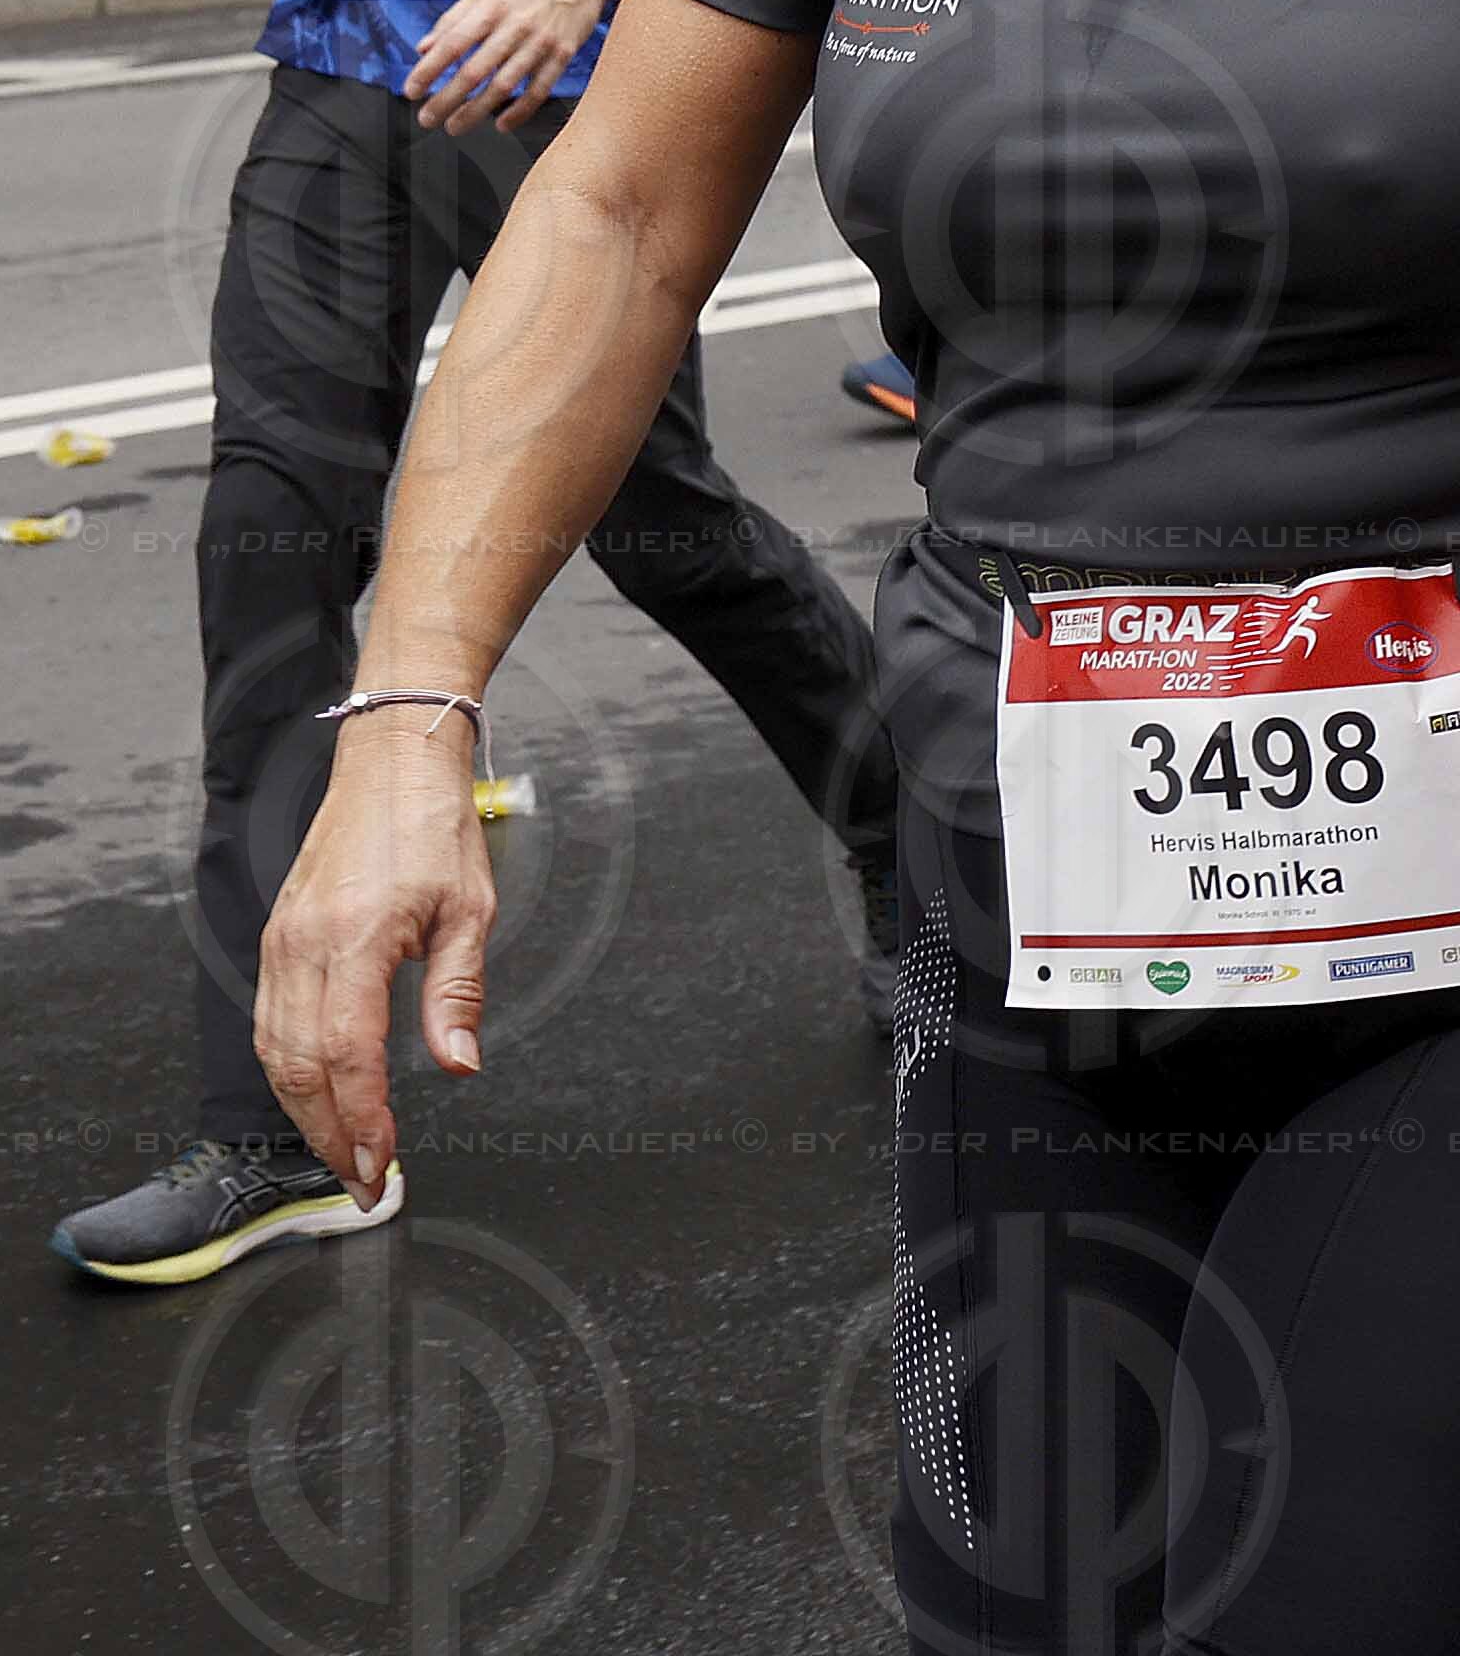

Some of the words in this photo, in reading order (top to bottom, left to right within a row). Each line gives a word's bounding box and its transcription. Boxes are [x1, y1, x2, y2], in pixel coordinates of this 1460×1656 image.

[869, 46, 917, 63] nature
[1055, 611, 1100, 627] KLEINE
[1107, 604, 1240, 644] GRAZ
[1053, 625, 1100, 641] ZEITUNG
[1373, 633, 1433, 662] Hervis
[1079, 648, 1198, 671] MARATHON
[1161, 672, 1214, 691] 2022
[1130, 710, 1385, 816] 3498
[1151, 833, 1215, 853] Hervis
[1221, 824, 1379, 851] Halbmarathon
[1188, 860, 1345, 901] Monika
[1069, 967, 1122, 984] GRAZ
[1333, 956, 1409, 978] PUNTIGAMER
